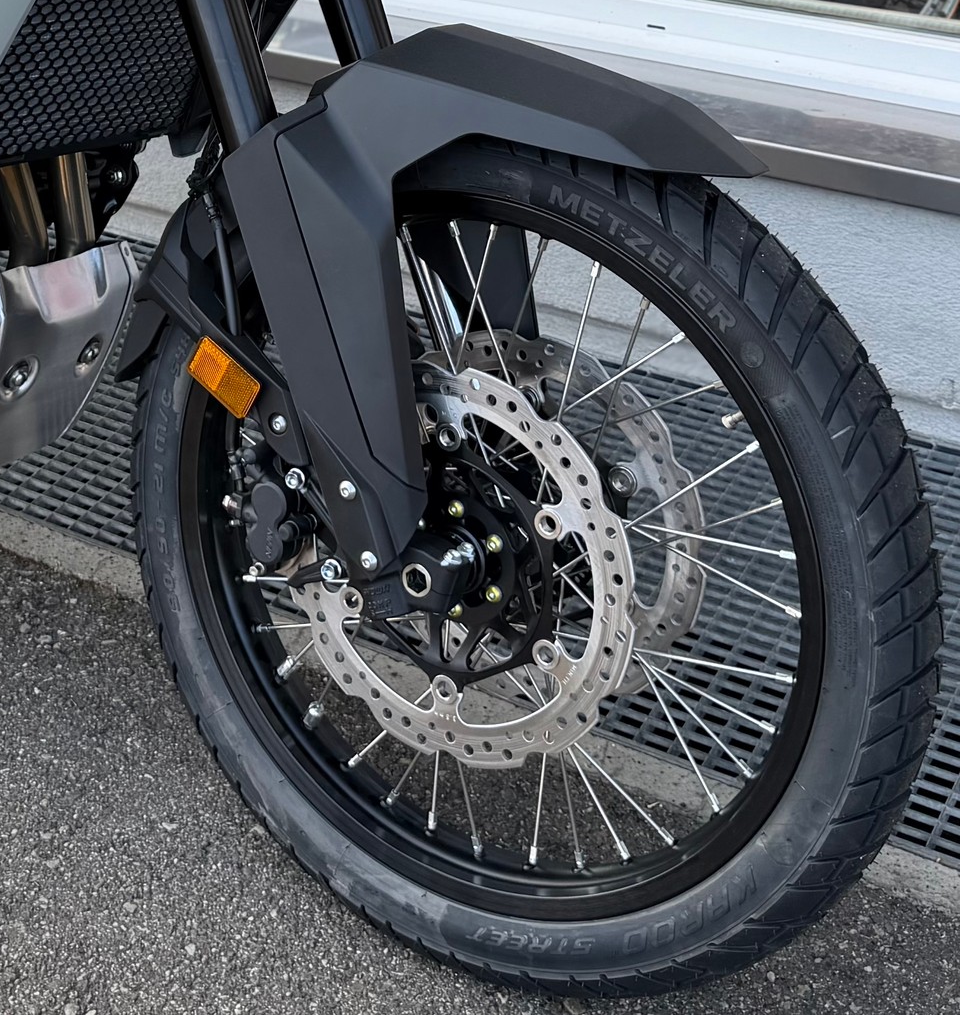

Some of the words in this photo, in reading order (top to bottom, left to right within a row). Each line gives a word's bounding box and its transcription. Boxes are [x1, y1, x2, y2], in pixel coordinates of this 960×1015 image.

[547, 184, 738, 334] METZELER
[465, 924, 596, 956] STREET
[622, 864, 758, 955] KAROO
